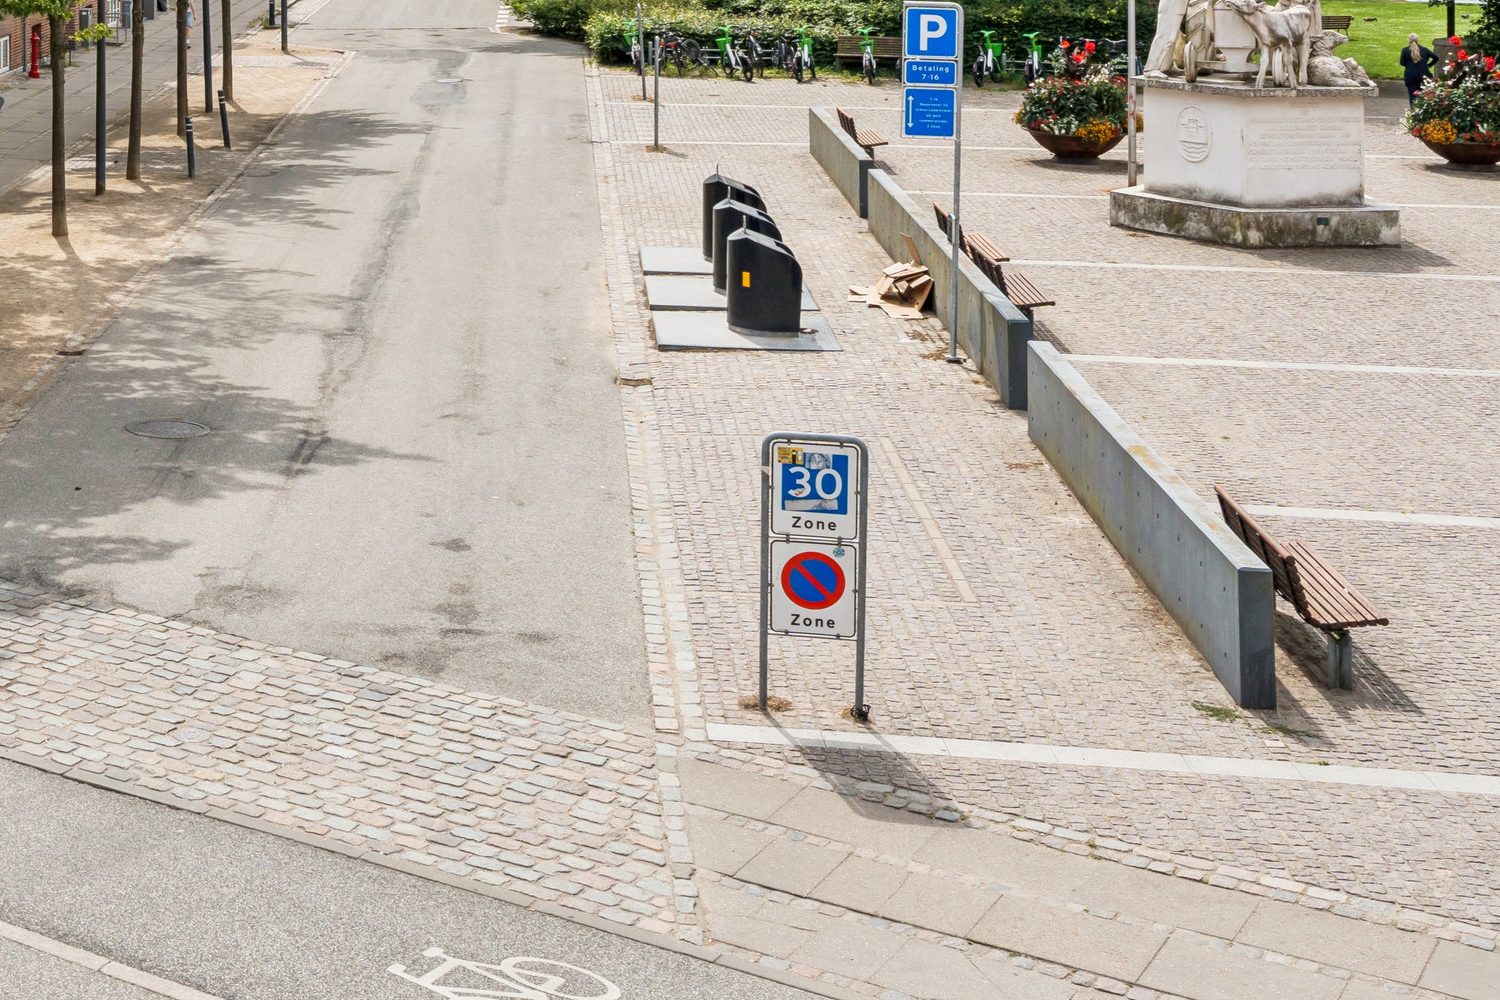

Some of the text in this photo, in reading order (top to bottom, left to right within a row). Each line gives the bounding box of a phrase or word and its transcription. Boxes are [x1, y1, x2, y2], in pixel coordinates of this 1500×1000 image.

[919, 14, 948, 51] P
[912, 64, 949, 73] Betaling
[787, 466, 843, 501] 30
[792, 516, 837, 532] Zone
[790, 614, 836, 630] Zone
